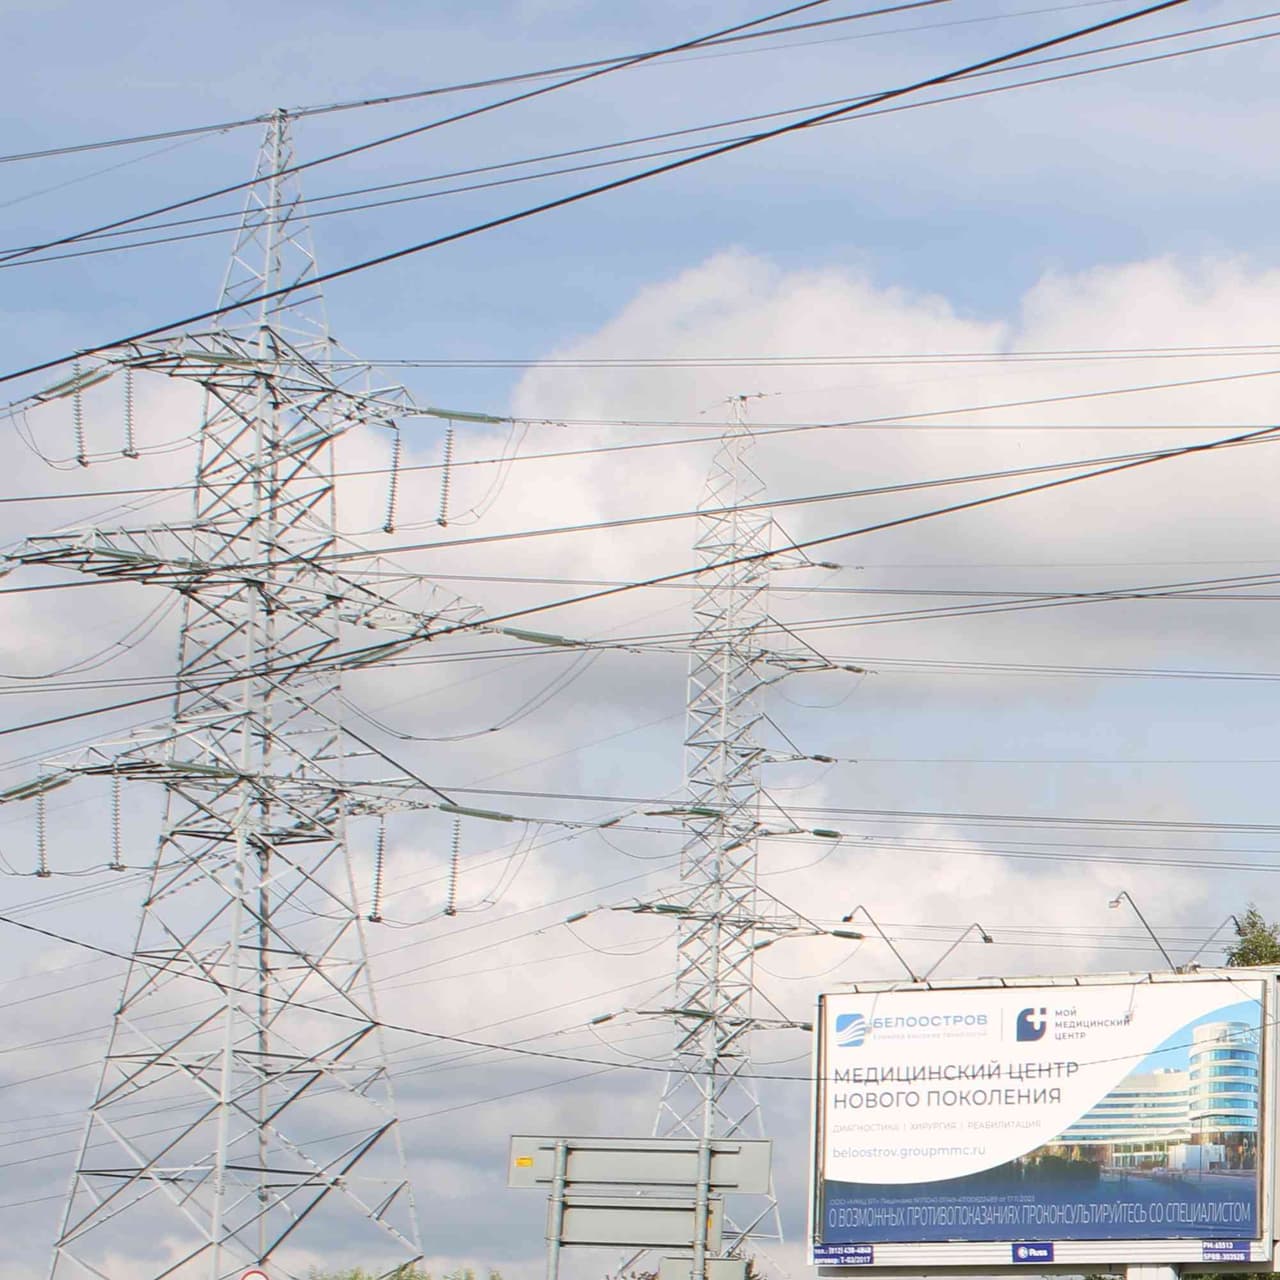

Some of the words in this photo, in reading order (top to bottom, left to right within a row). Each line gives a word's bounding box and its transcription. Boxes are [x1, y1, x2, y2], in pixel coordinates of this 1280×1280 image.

[1055, 1005, 1077, 1017] МОЙ
[873, 1014, 988, 1029] БЕЛООСТРОВ
[1055, 1015, 1130, 1029] МЕДИЦИНСКИЙ
[1055, 1031, 1086, 1041] ЦЕНТР
[834, 1059, 1001, 1086] МЕДИЦИНСКИЙ
[1009, 1061, 1079, 1083] ЦЕНТР
[833, 1090, 920, 1109] НОВОГО
[927, 1088, 1062, 1107] ПОКОЛЕНИЯ
[967, 1119, 1041, 1129] РЕАБИЛИТАЦИЯ
[832, 1145, 986, 1160] beloostrov.groupmmc.ru
[829, 1208, 837, 1228] О
[839, 1207, 905, 1227] ВОЗМОЖНЫХ
[908, 1204, 1021, 1226] ПРОТИВОПОКАЗАНИЯХ
[1023, 1201, 1147, 1225] ПРОКОНСУЛЬТИРУЙТЕСЬ
[1149, 1202, 1164, 1223] СО
[1166, 1200, 1251, 1223] СПЕЦИАЛИСТОМ
